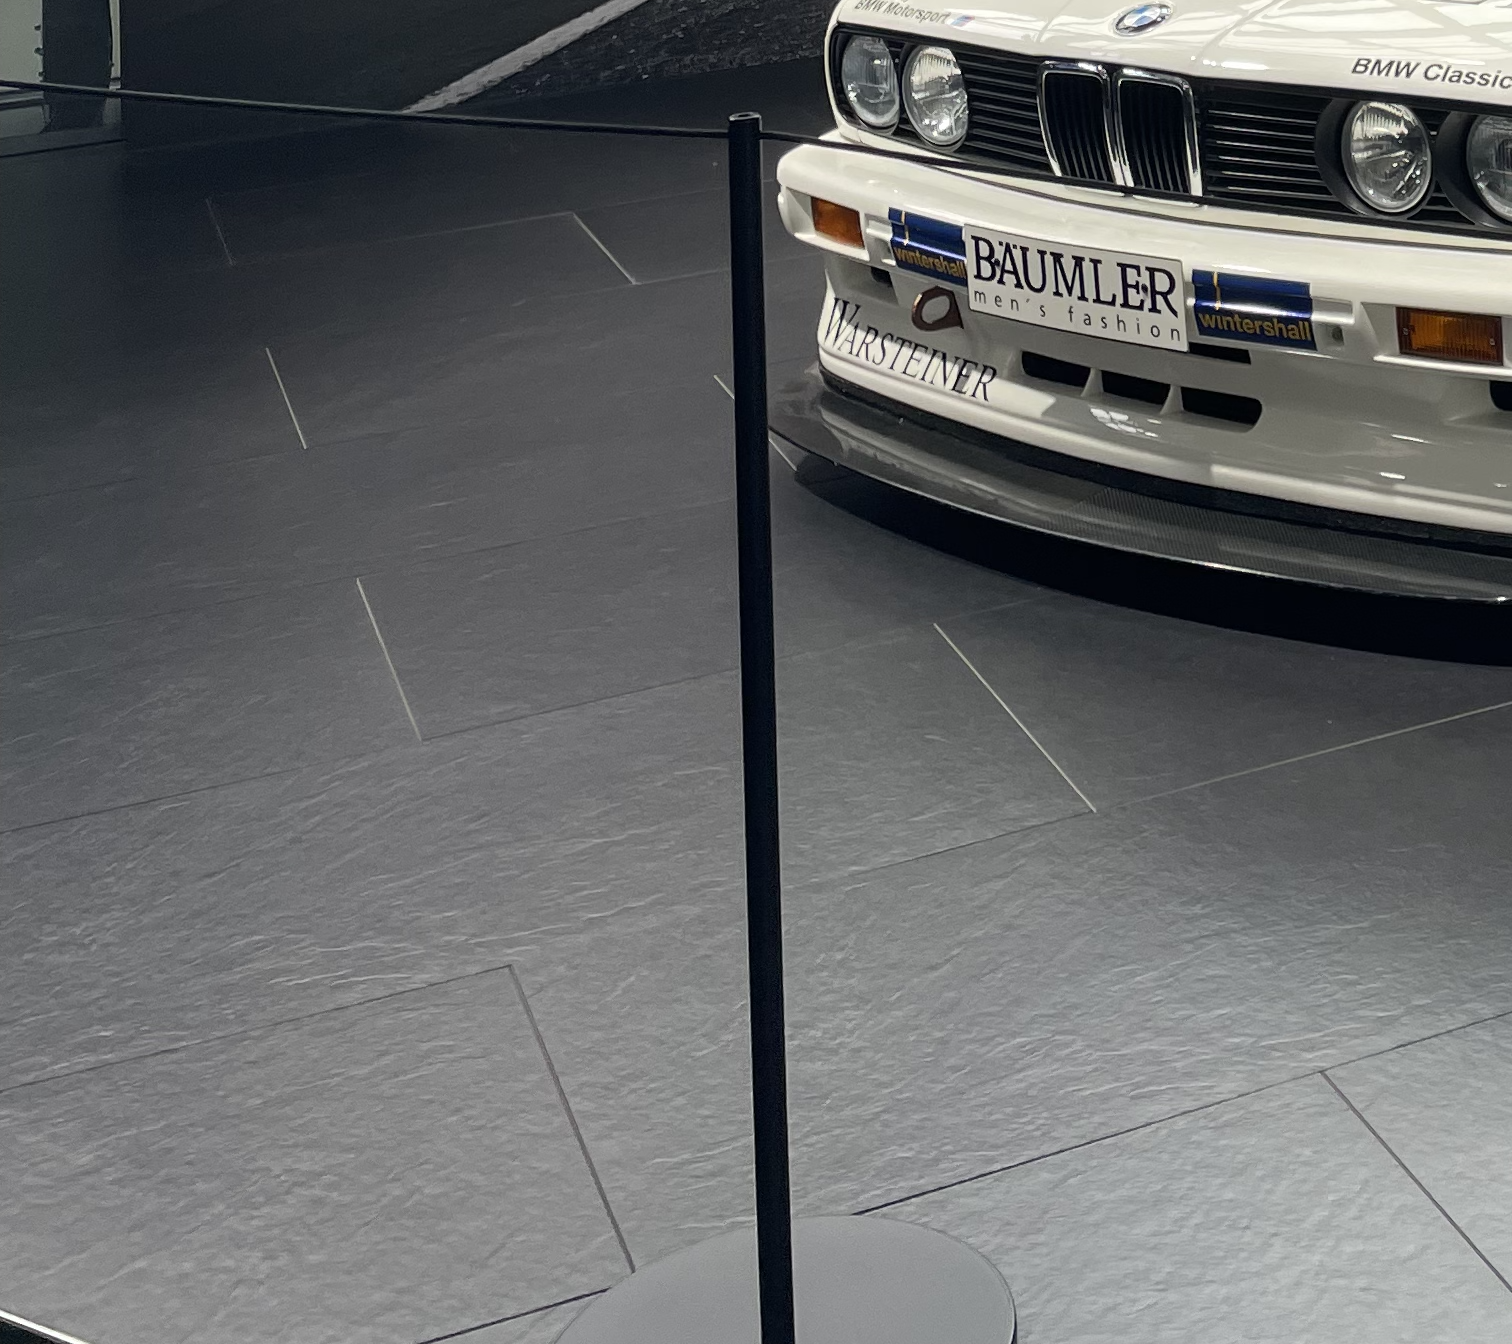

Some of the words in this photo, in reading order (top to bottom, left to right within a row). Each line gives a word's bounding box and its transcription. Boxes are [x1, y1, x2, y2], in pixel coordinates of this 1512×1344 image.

[884, 1, 952, 24] Motorsport
[1351, 57, 1422, 80] BMW
[893, 247, 968, 280] wintershall
[970, 234, 1180, 319] BÄUMLER
[1067, 305, 1182, 343] fashion
[1201, 311, 1314, 343] wintershall
[824, 296, 998, 403] WARSTEINER
